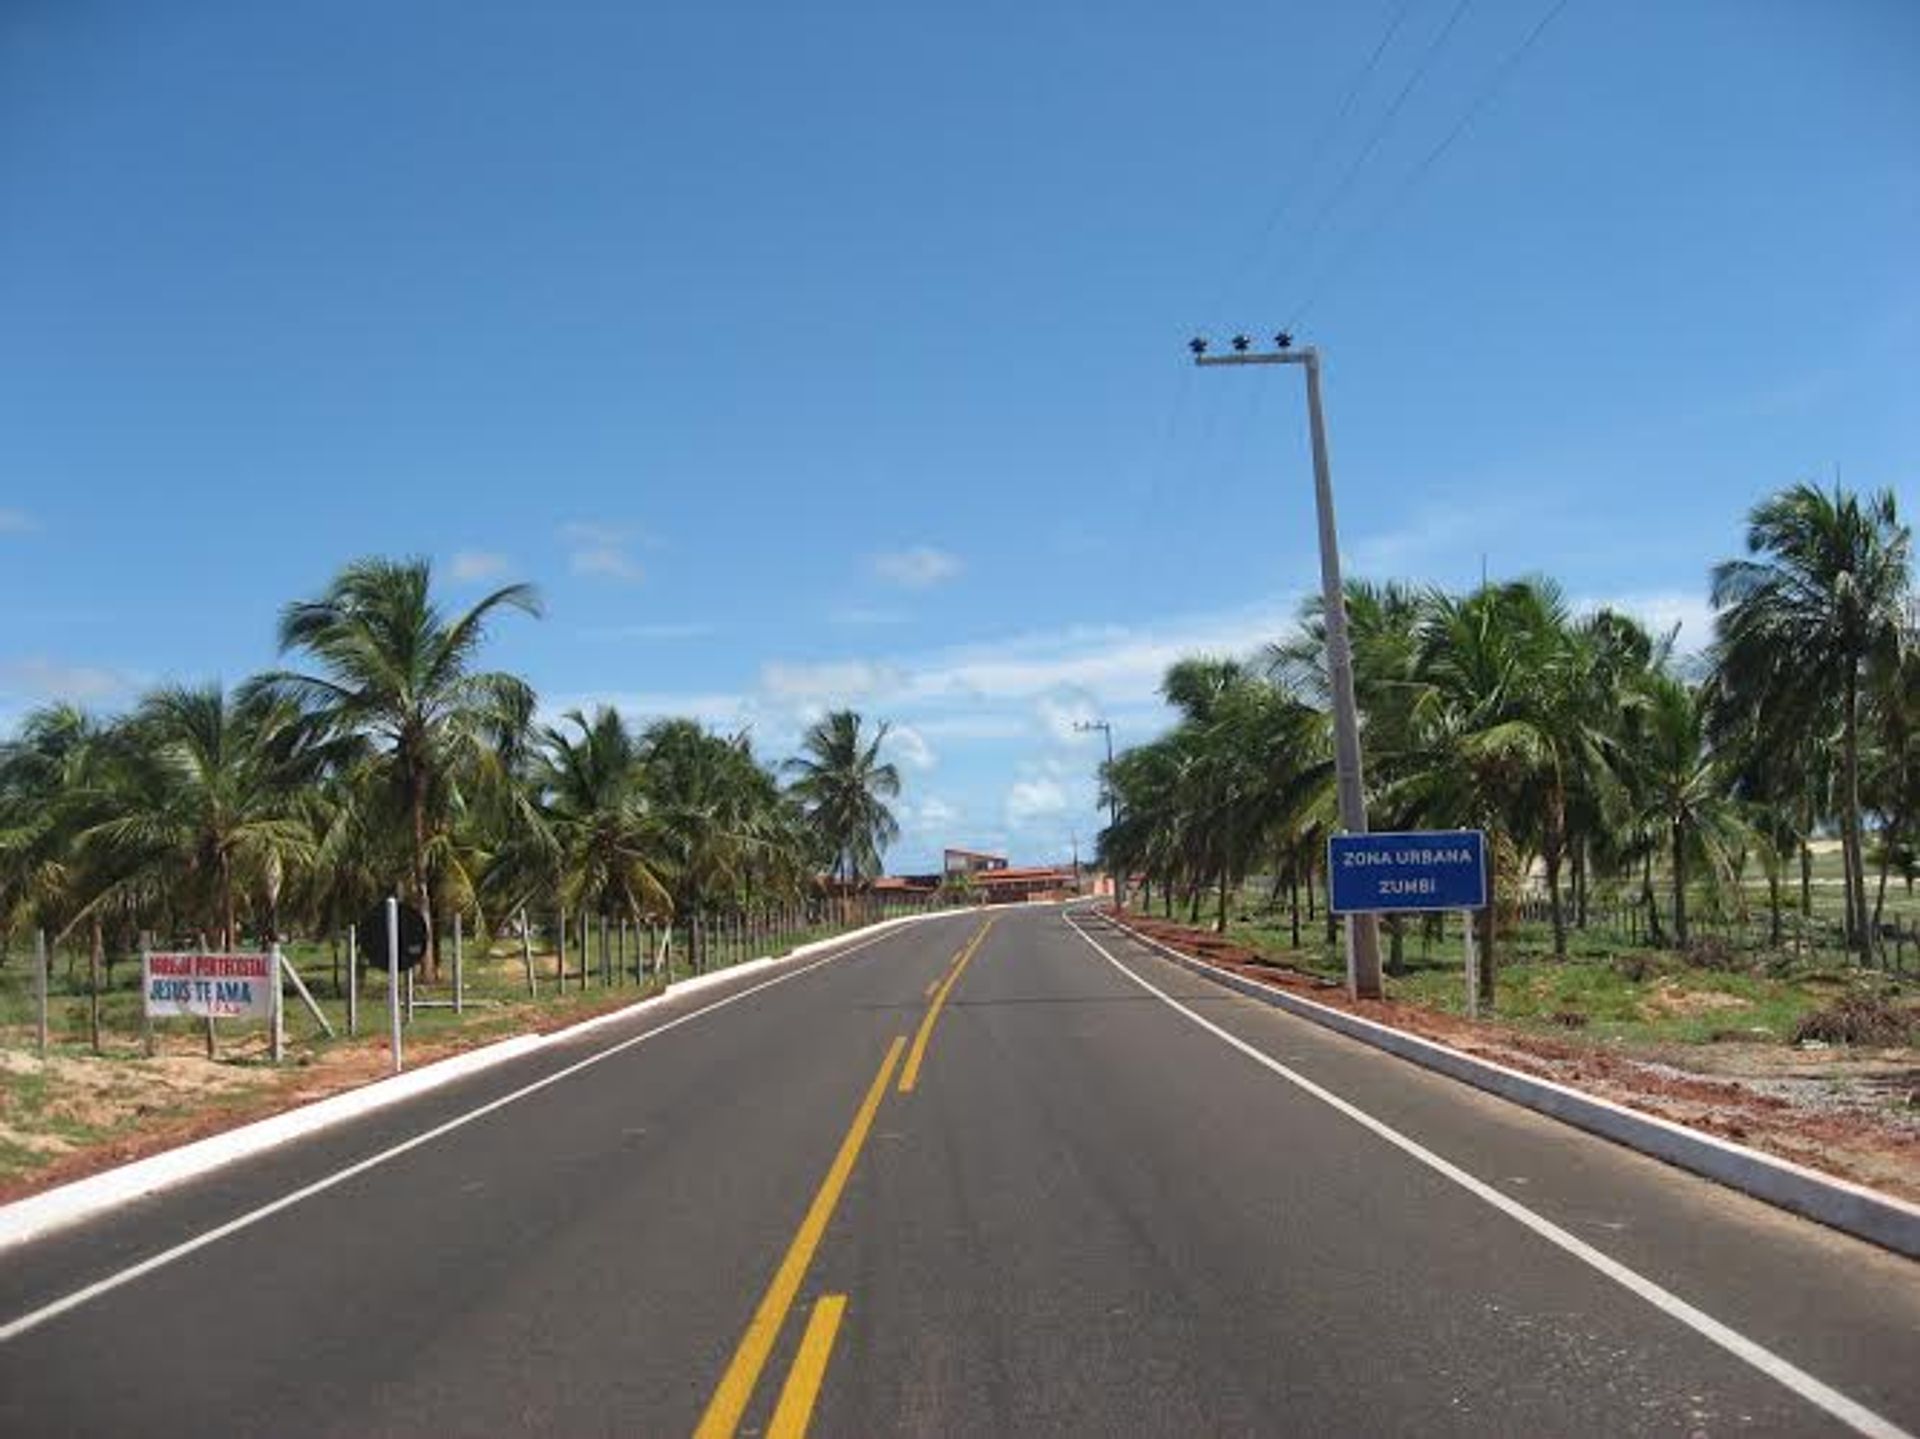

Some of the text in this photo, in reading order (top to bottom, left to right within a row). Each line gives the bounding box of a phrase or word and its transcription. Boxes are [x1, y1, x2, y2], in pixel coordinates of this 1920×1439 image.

[1342, 849, 1472, 866] ZONA URBANA
[1379, 878, 1435, 894] ZUMBI
[150, 980, 252, 1003] JESUS TE AMA
